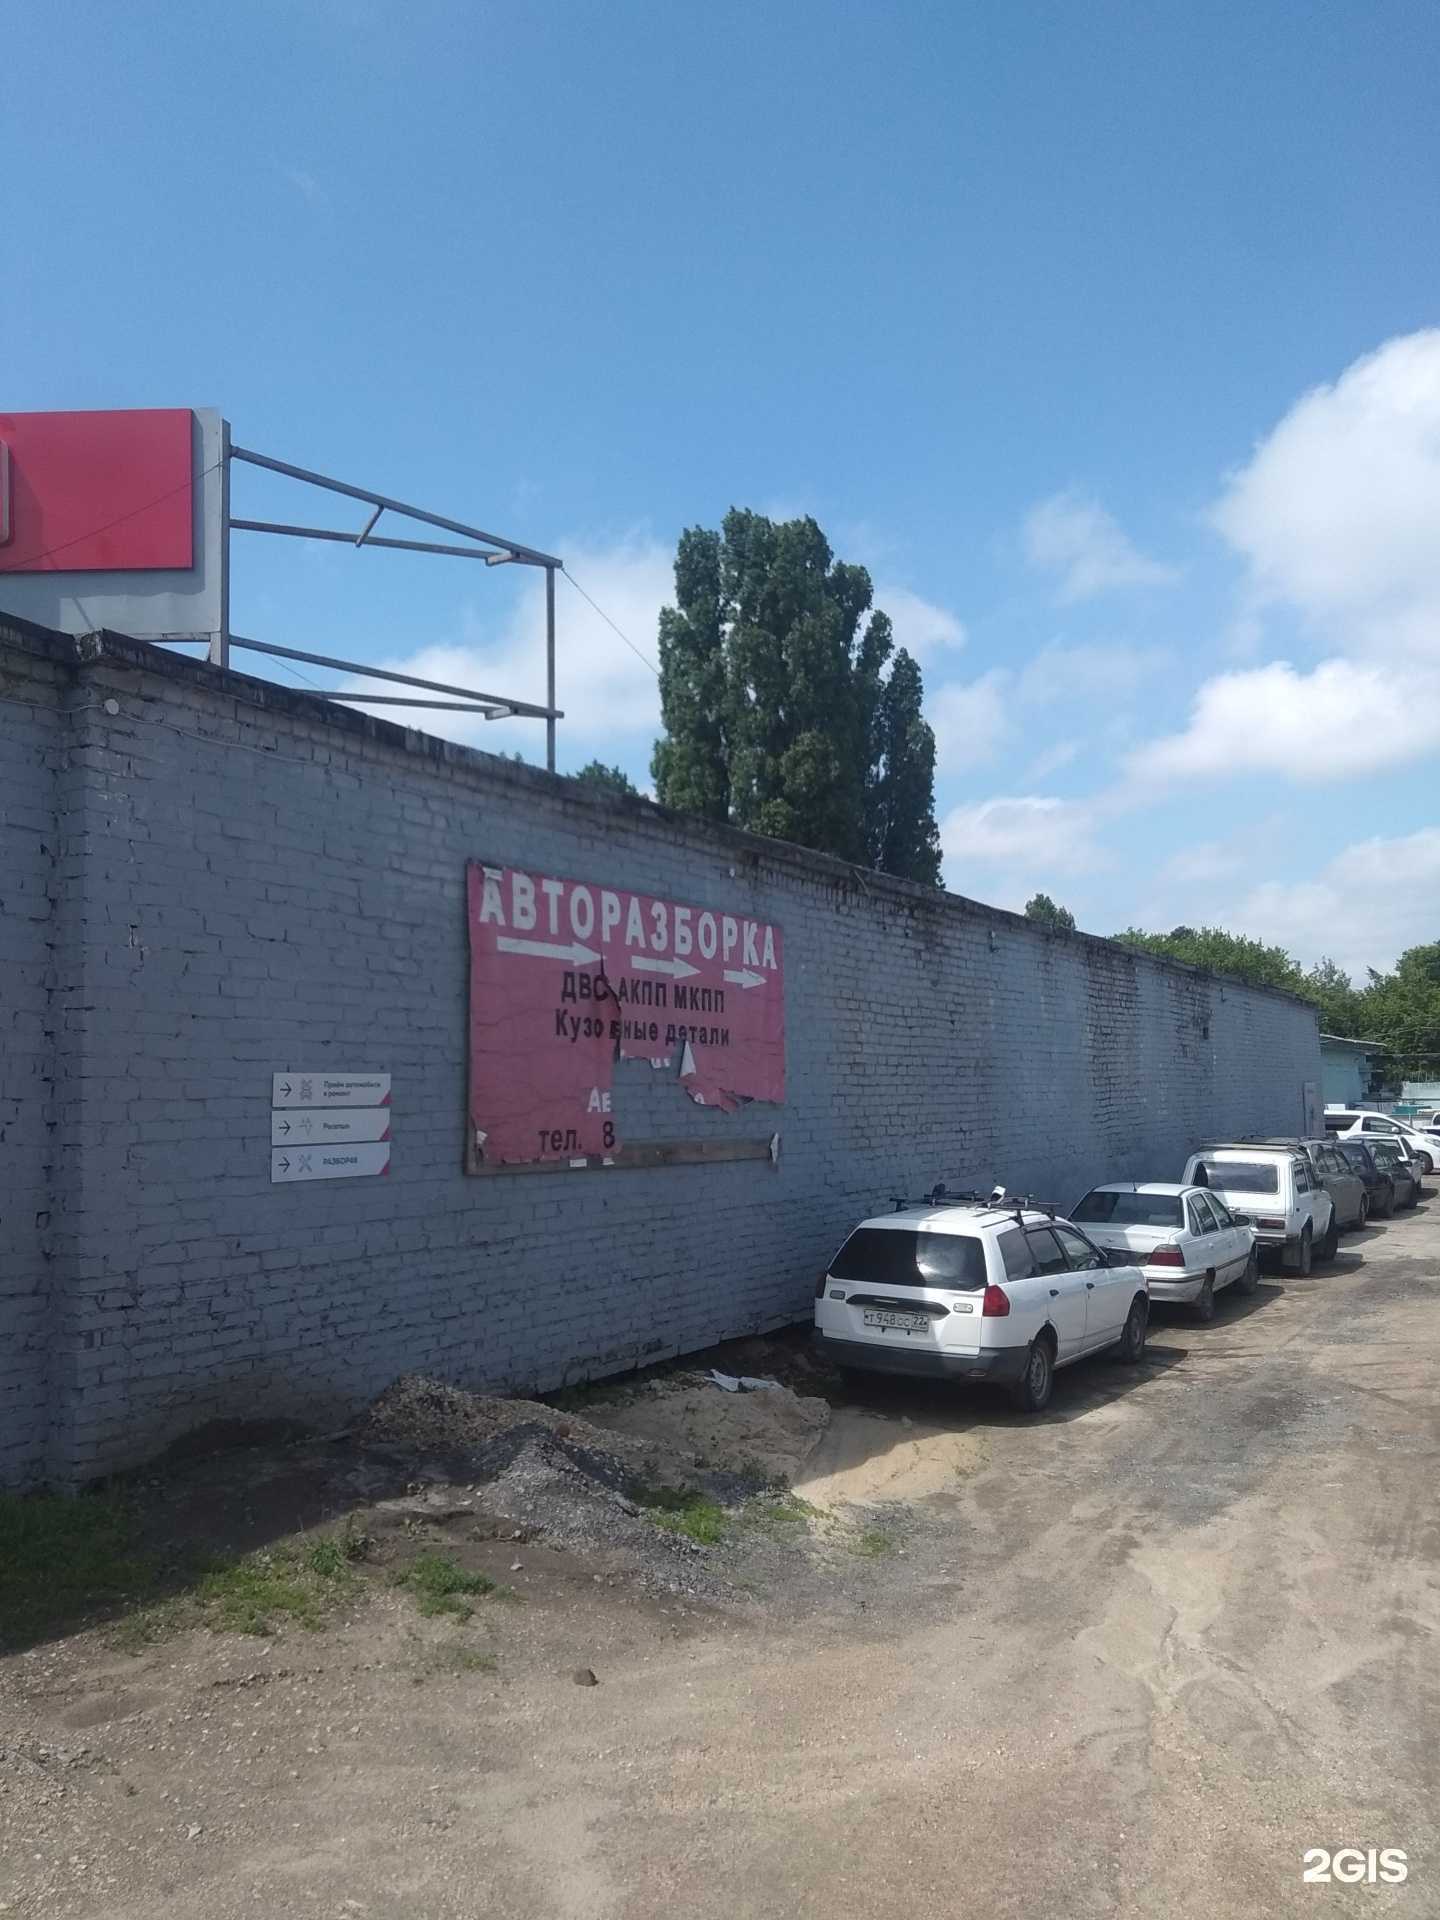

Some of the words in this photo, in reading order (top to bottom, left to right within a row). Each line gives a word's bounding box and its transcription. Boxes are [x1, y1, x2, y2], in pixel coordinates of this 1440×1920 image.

[479, 872, 778, 971] АВТОРАЗБОРКА
[561, 971, 609, 1004] ДВС
[618, 976, 667, 1008] АКПП
[674, 983, 725, 1014] МКПП
[665, 1022, 730, 1047] детали
[538, 1129, 583, 1152] тел.
[602, 1120, 616, 1150] 8
